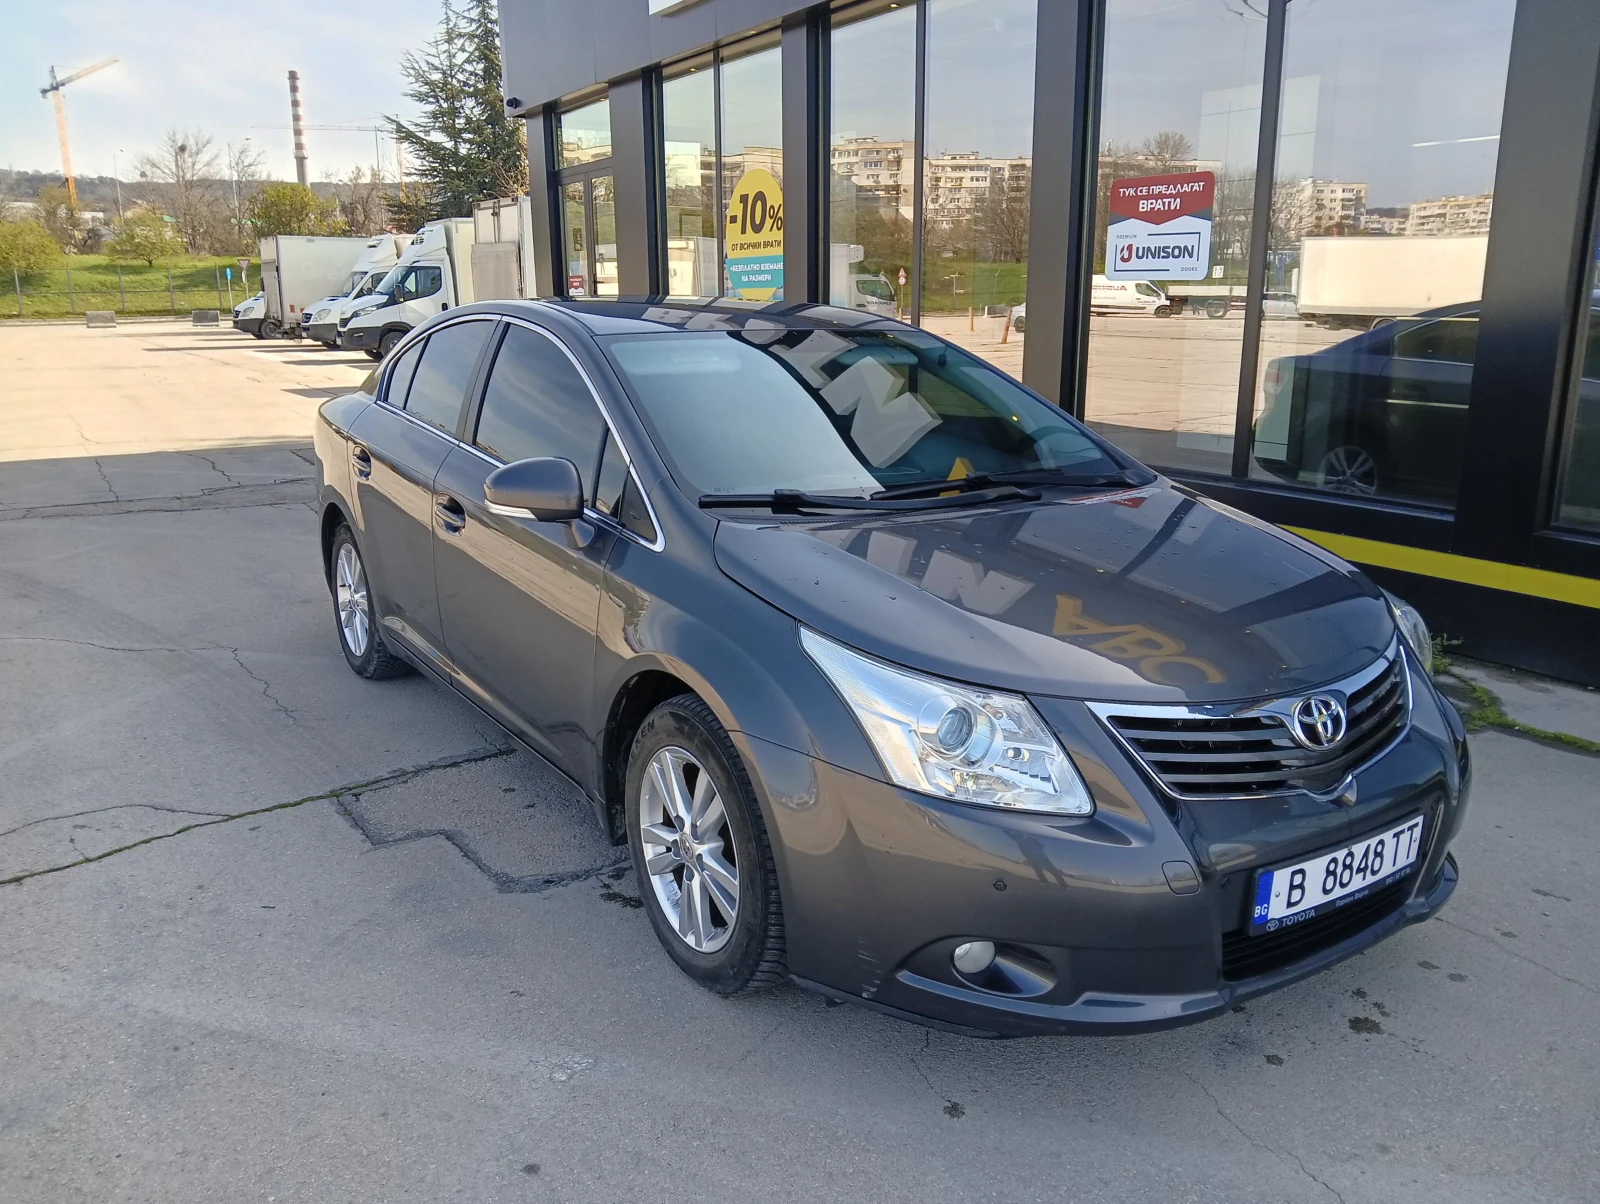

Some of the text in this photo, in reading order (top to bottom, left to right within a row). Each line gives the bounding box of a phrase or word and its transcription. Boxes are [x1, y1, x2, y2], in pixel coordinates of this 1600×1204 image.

[1119, 182, 1205, 197] ТУК СЕ ПРЕДЛАГАТ
[1138, 197, 1181, 212] ВРАТИ
[729, 190, 783, 235] -10%
[731, 239, 782, 252] ОТ ВСИЧКИ ВРАТИ
[1135, 245, 1195, 260] UNISON
[749, 273, 772, 282] РАЗМЕРИ
[1322, 838, 1386, 896] 8848
[1391, 821, 1420, 868] TT
[1254, 903, 1268, 918] BG
[1282, 908, 1316, 927] TOYOTA
